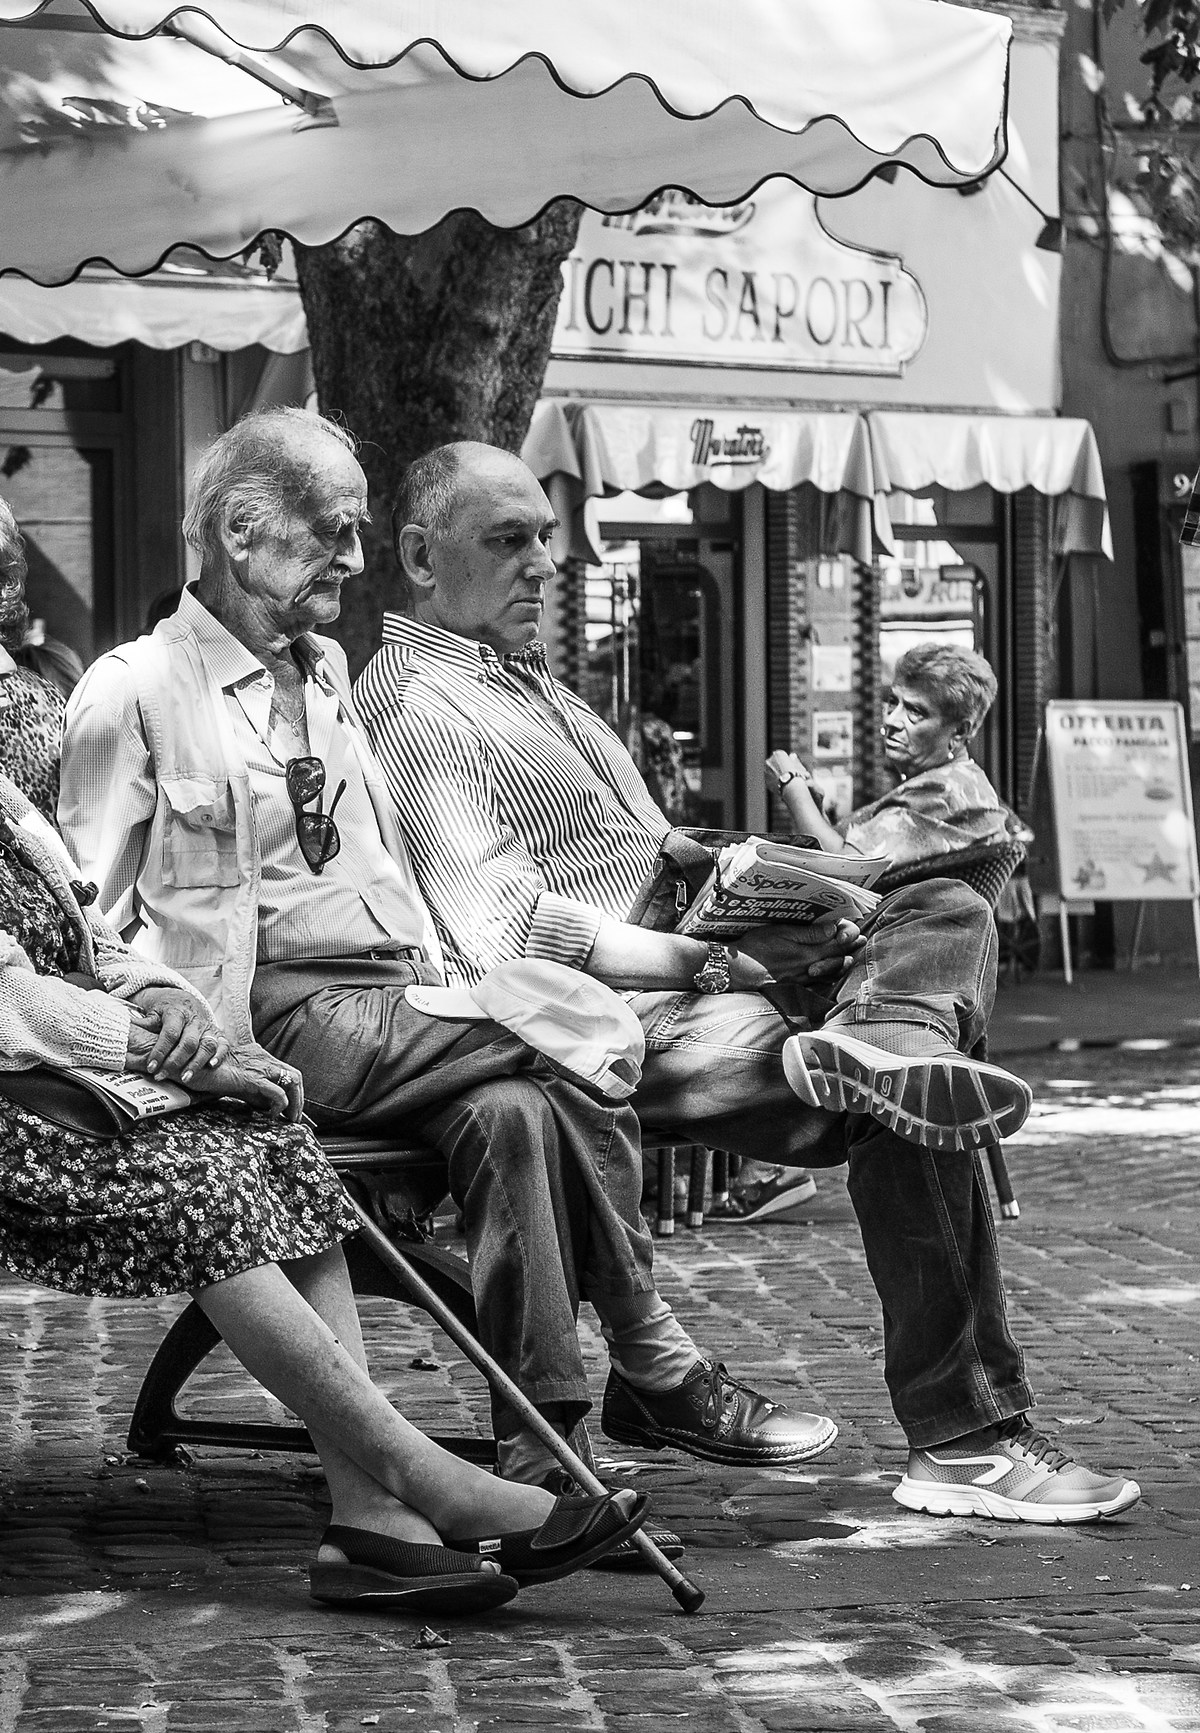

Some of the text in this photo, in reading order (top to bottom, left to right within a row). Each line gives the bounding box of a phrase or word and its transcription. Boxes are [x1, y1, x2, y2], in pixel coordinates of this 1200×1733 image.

[702, 265, 893, 350] SAPORI
[1060, 715, 1165, 731] OFFERTA
[746, 874, 808, 892] Sport
[726, 907, 767, 917] della
[741, 898, 813, 911] Spalletti
